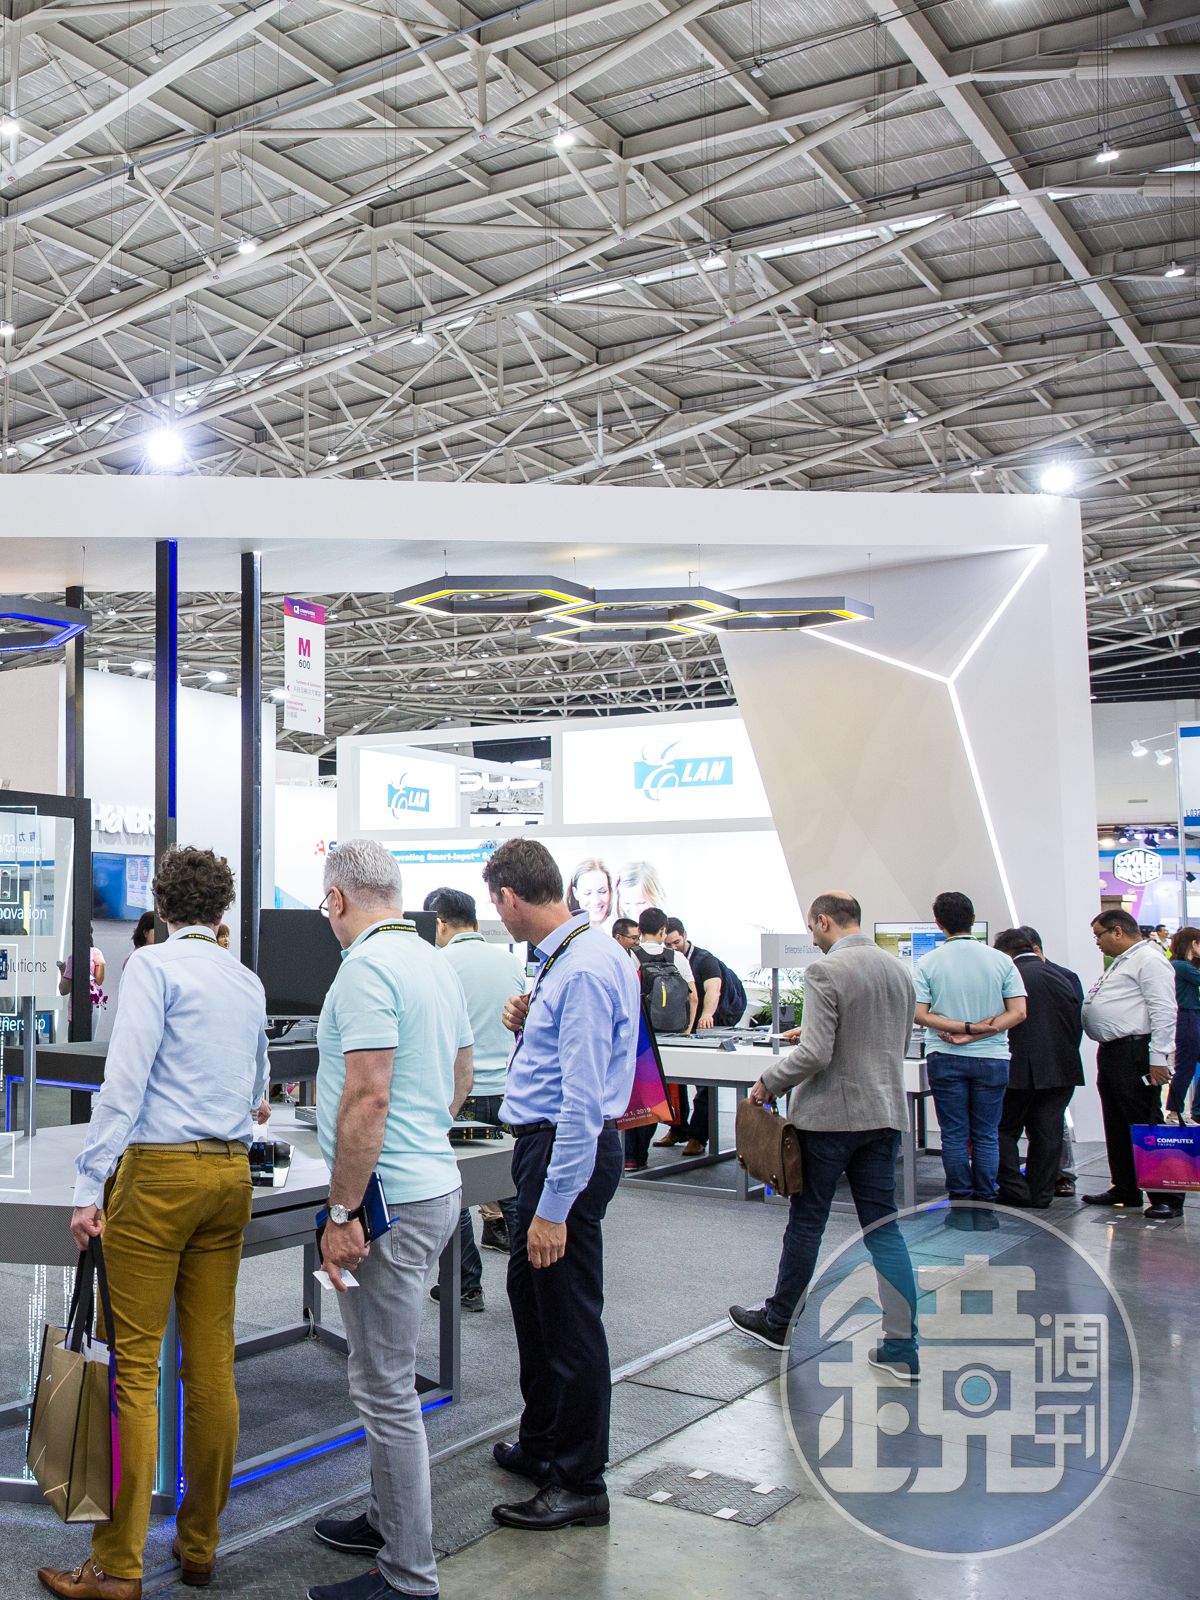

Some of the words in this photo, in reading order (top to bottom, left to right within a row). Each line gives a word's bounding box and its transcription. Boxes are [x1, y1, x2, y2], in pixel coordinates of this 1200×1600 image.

[299, 637, 311, 657] M
[298, 659, 311, 670] 600
[1156, 1137, 1194, 1145] COMPUTEX
